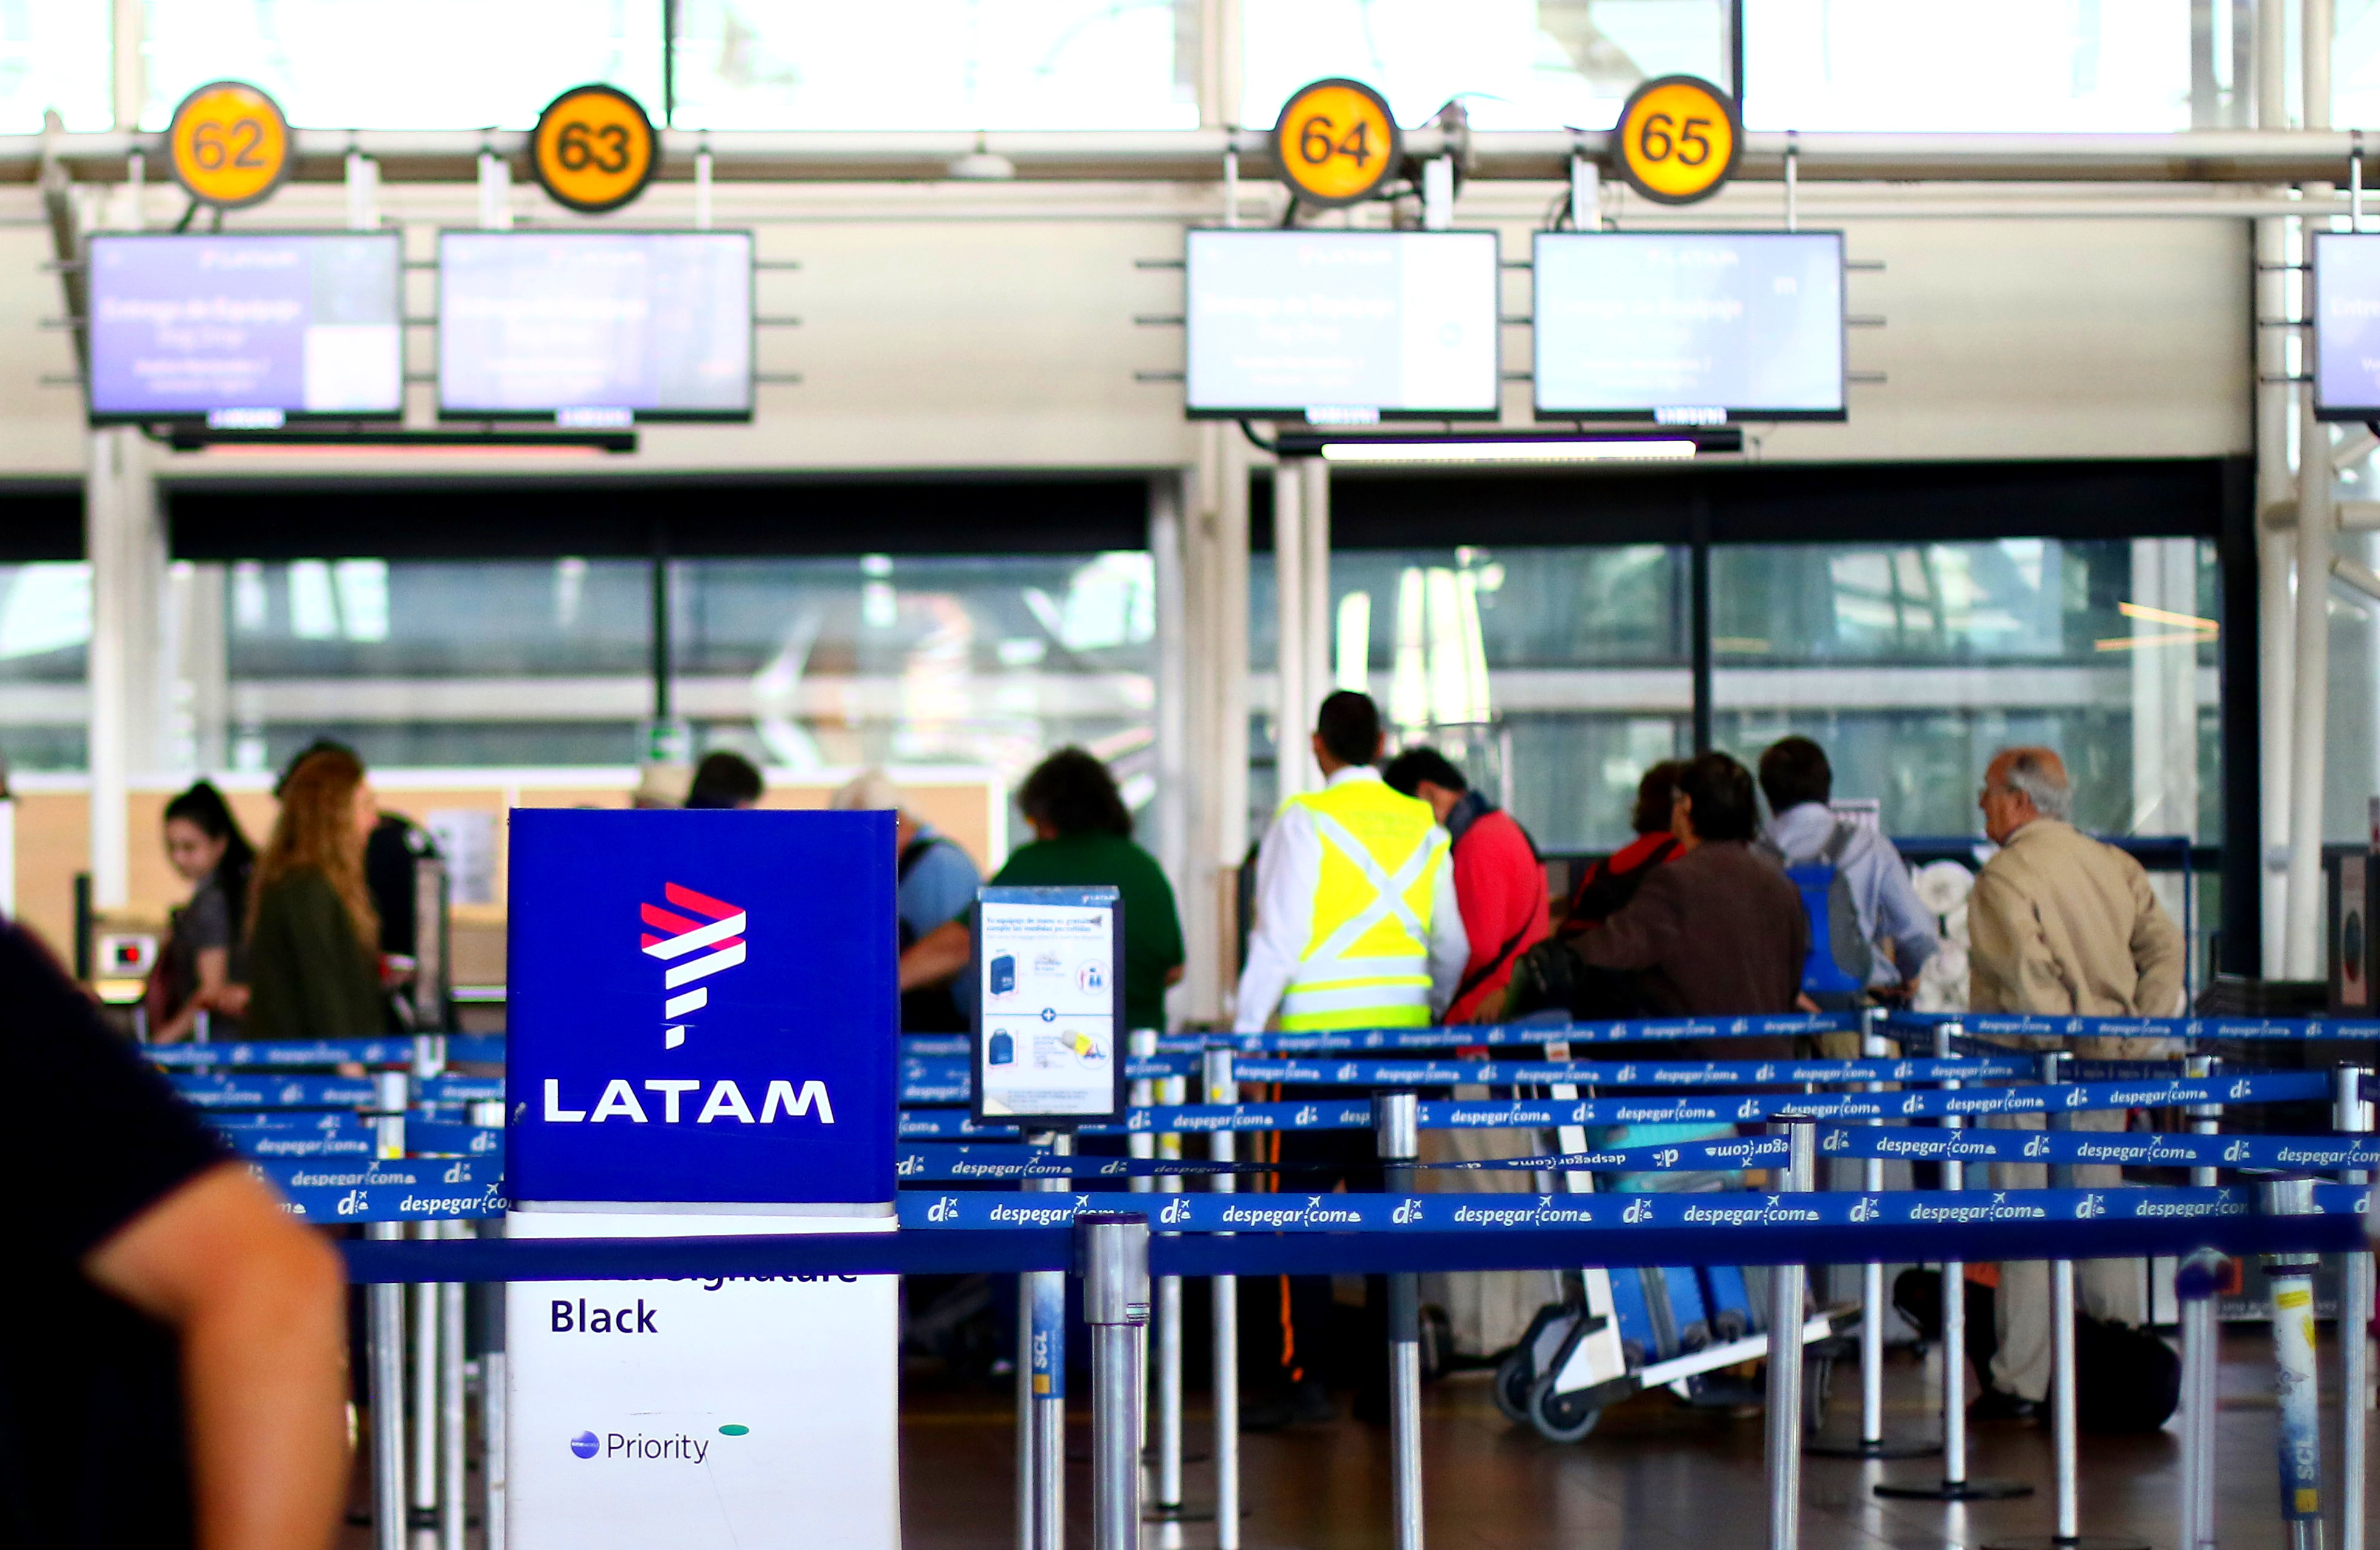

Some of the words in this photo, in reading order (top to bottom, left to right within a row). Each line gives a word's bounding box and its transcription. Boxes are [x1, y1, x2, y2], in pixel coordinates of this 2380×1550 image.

[192, 120, 266, 170] 62
[558, 122, 632, 173] 63
[1300, 116, 1371, 167] 64
[1640, 113, 1711, 166] 65
[544, 1078, 835, 1124] LATAM
[401, 1195, 508, 1215] despegar.co
[551, 1298, 659, 1334] Black
[1034, 1330, 1048, 1369] SCL
[607, 1432, 710, 1464] Priority
[2296, 1440, 2314, 1481] SCL
